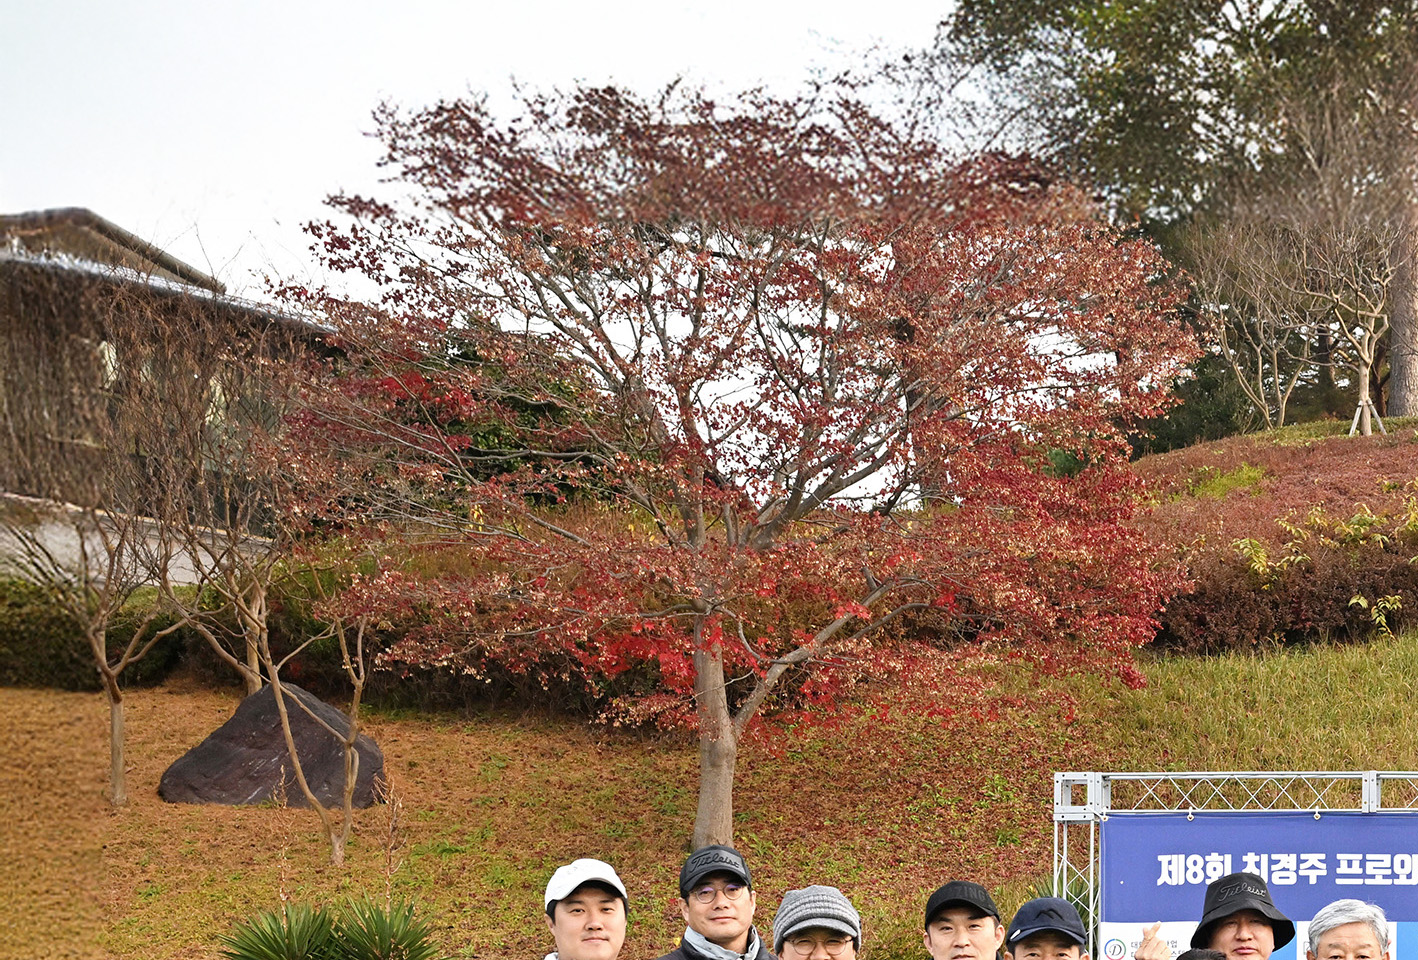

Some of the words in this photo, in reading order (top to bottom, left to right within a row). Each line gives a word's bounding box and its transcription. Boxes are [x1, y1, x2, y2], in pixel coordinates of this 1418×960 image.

[690, 851, 740, 873] Titleist
[1157, 852, 1232, 886] 제8회
[1242, 852, 1328, 886] 최경주
[1219, 881, 1267, 901] Titleist
